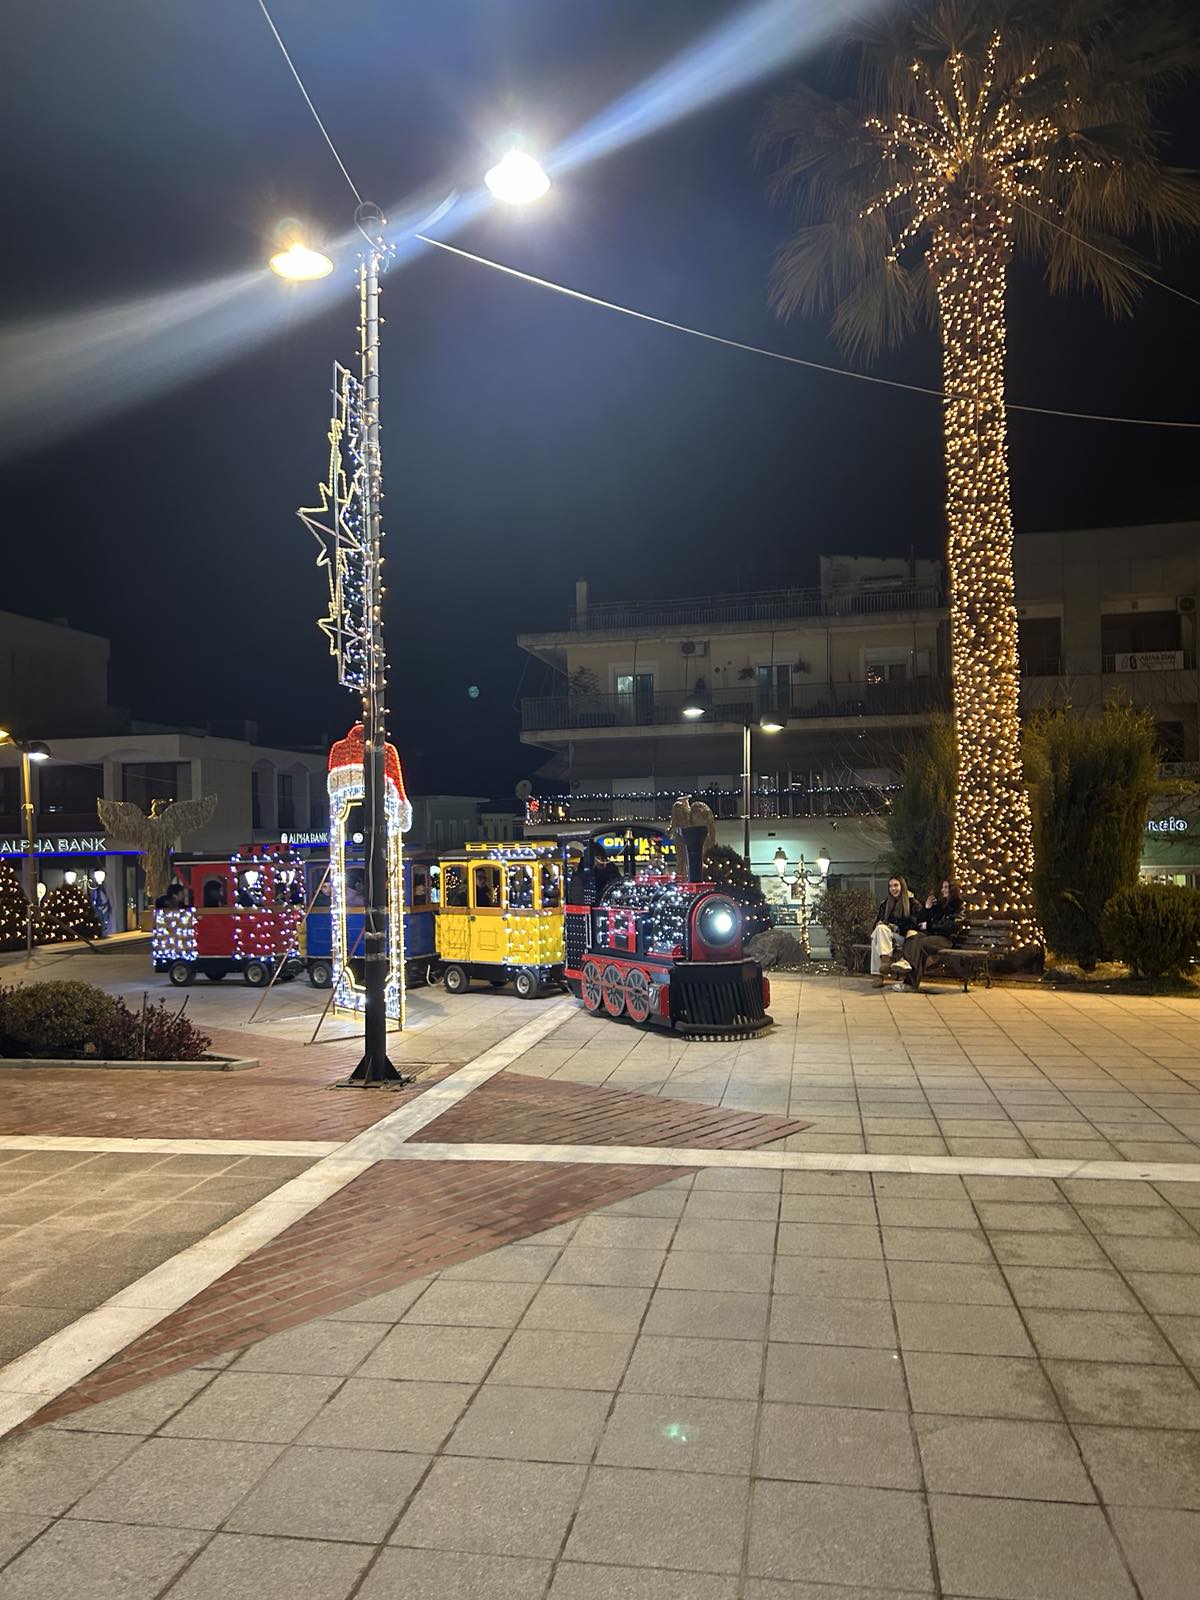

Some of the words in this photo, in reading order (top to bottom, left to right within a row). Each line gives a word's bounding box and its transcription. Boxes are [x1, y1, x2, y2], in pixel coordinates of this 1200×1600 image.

[289, 832, 311, 844] ALPHA
[311, 832, 328, 844] BANK
[0, 839, 55, 853] ALPHA
[58, 838, 107, 852] BANK
